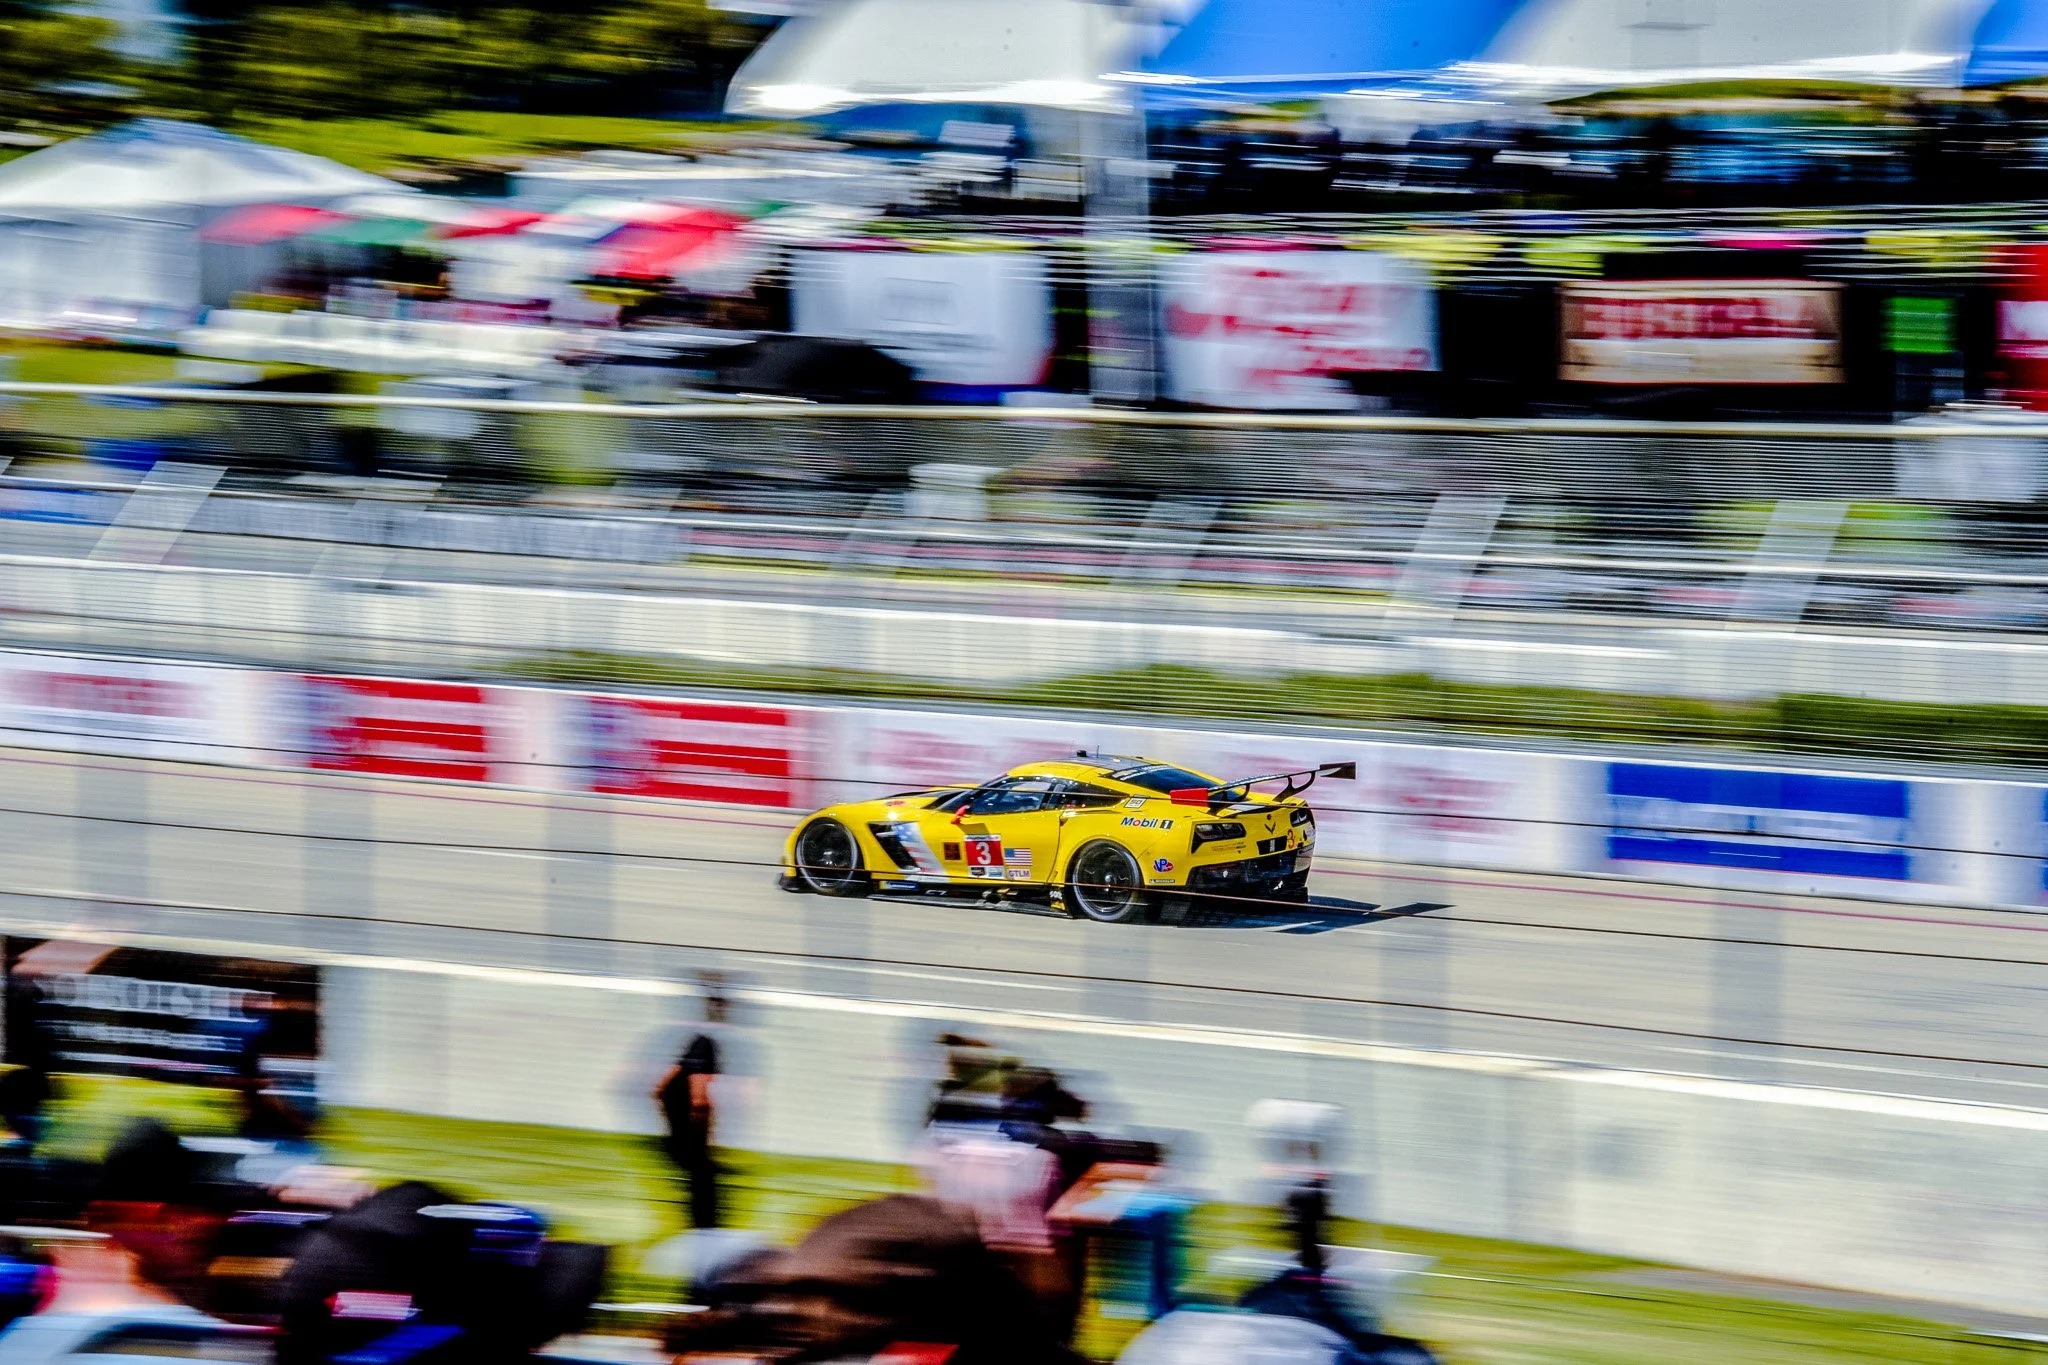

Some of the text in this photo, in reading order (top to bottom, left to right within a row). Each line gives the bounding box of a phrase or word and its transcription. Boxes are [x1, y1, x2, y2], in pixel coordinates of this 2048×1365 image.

[1120, 816, 1172, 829] Mobil 1
[975, 841, 992, 865] 3
[1154, 858, 1168, 872] VP
[1008, 870, 1031, 878] GTLM
